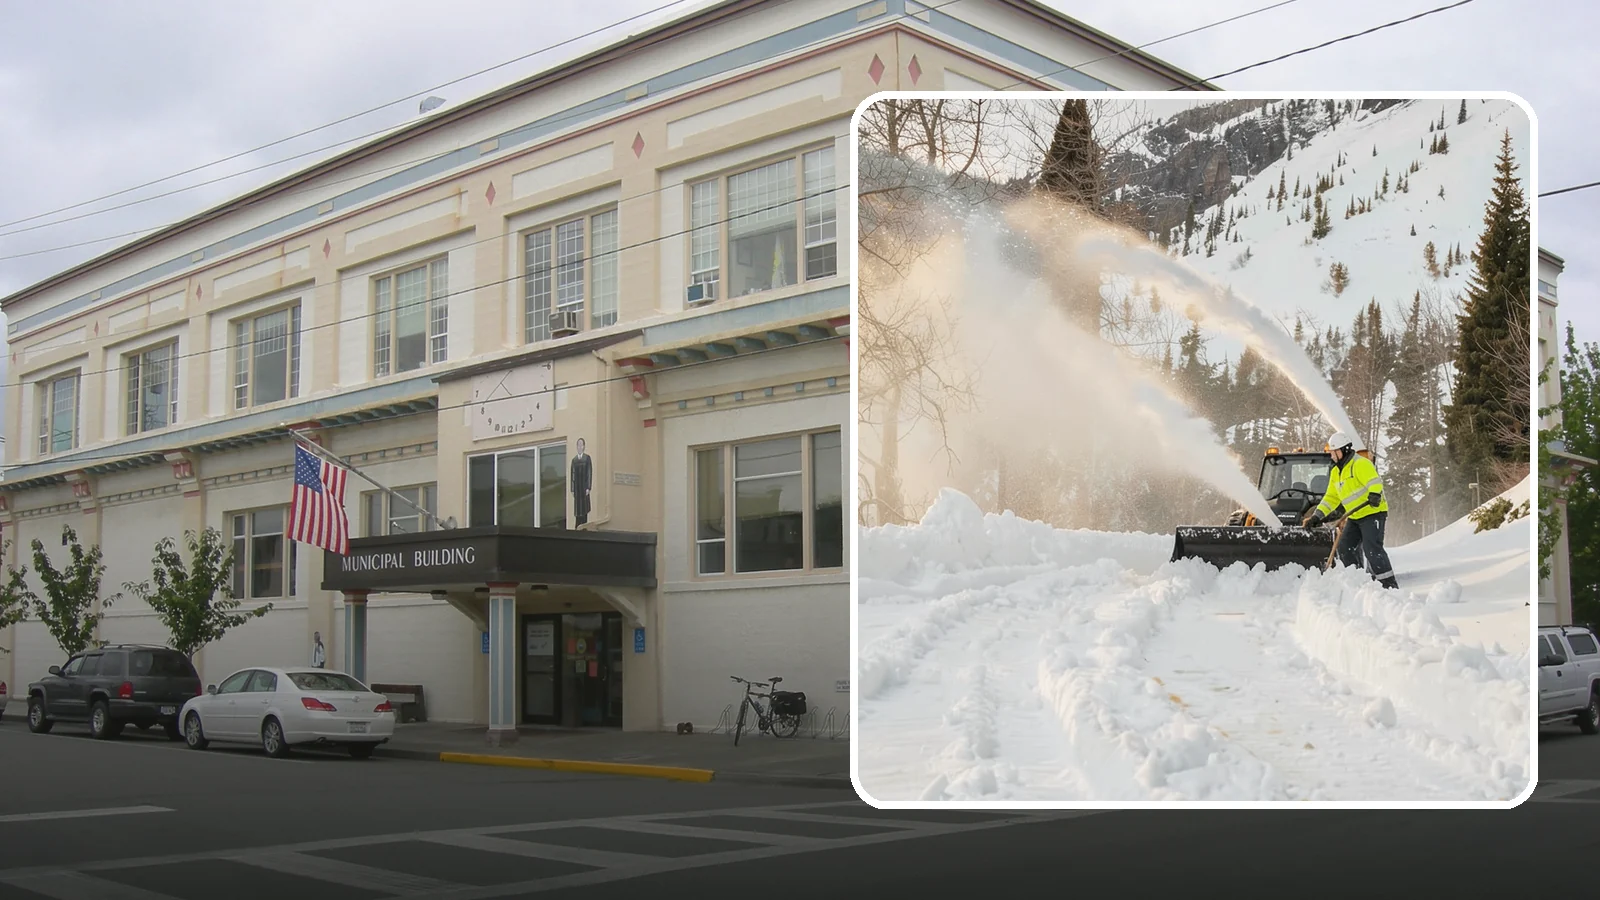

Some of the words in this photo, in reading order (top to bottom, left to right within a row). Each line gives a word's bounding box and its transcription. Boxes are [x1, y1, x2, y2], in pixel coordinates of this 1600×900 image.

[480, 407, 485, 415] 8
[487, 417, 492, 425] 9
[495, 423, 500, 432] 10
[501, 425, 506, 433] 11
[508, 425, 513, 433] 12
[521, 420, 526, 428] 2
[529, 414, 533, 422] 3
[342, 552, 405, 571] MUNICIPAL
[414, 547, 475, 567] BUILDING
